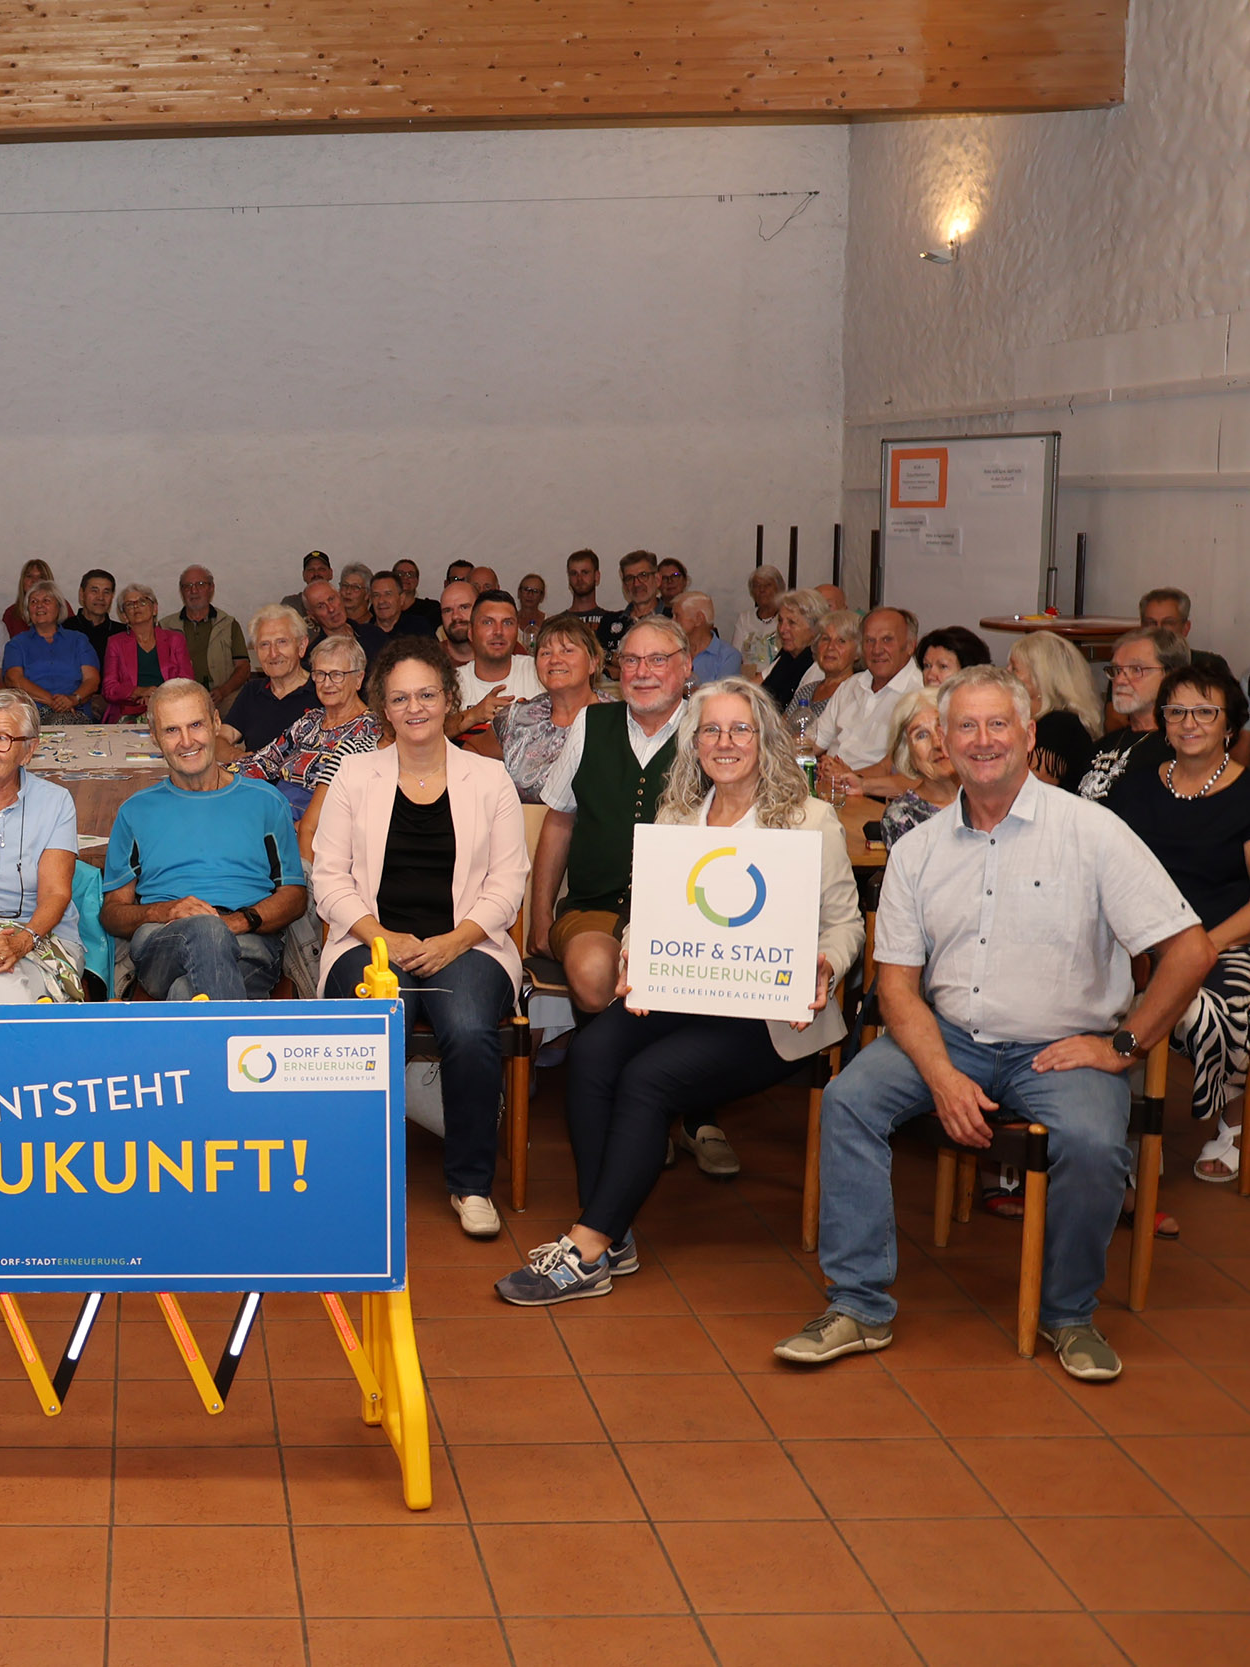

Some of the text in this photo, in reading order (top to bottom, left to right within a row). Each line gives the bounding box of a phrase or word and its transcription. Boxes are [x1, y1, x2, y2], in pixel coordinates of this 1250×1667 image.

[650, 940, 794, 964] DORF & STADT
[649, 962, 772, 984] ERNEUERUNG
[648, 985, 790, 1002] DIE GEMEINDEAGENTUR
[283, 1046, 376, 1058] DORF & STADT
[283, 1061, 363, 1071] ERNEUERUNG
